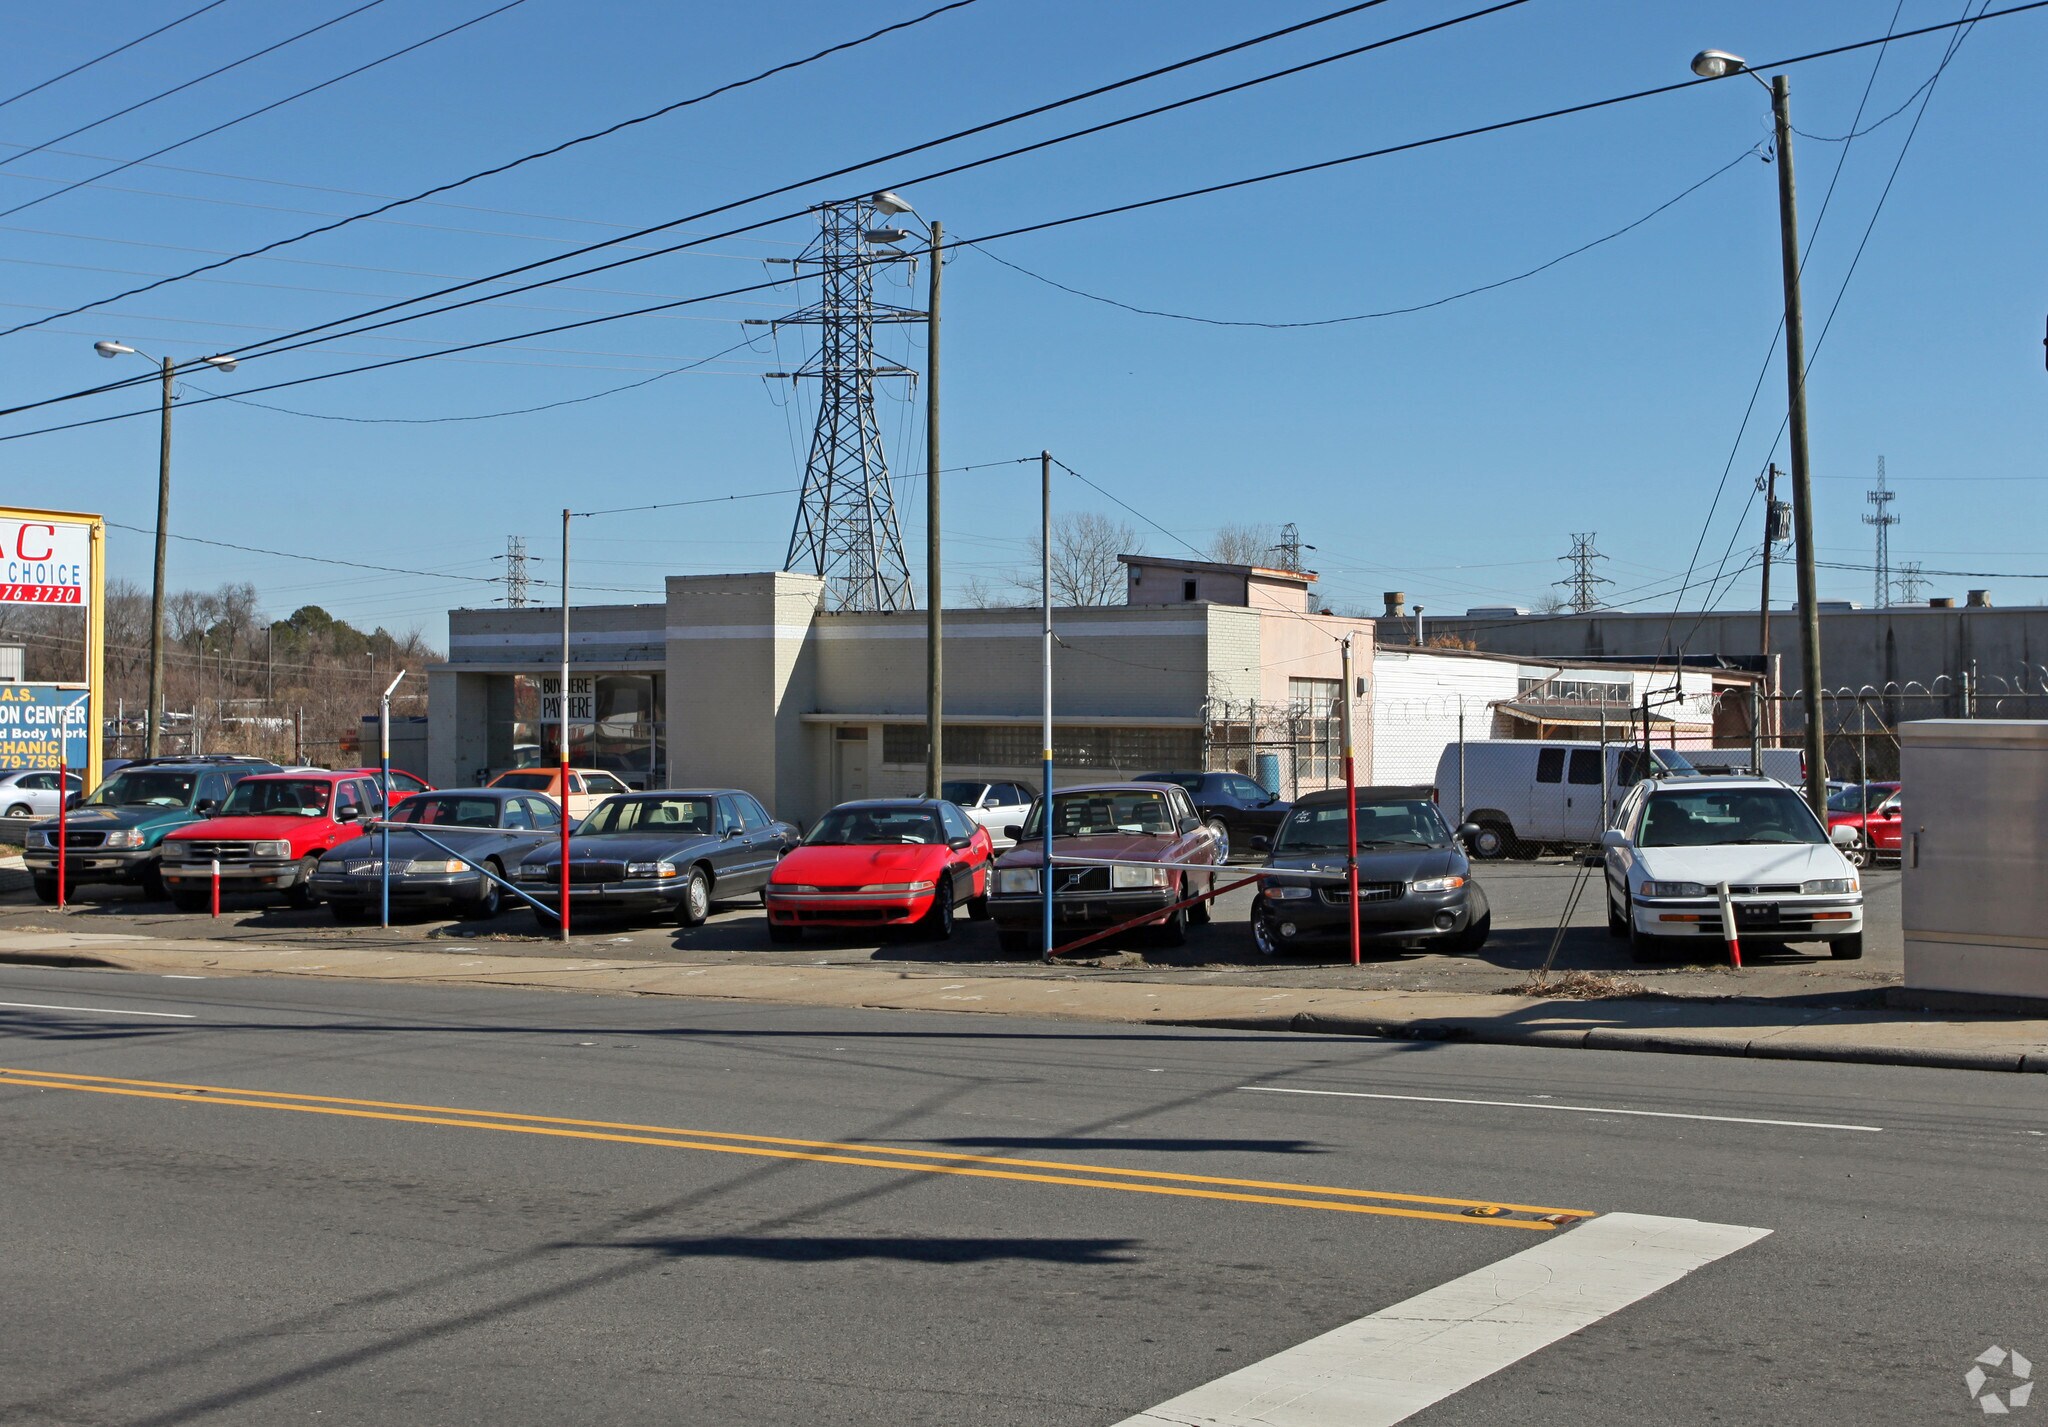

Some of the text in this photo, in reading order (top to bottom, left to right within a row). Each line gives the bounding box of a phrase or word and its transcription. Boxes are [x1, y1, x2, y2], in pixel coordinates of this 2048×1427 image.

[0, 524, 55, 561] C
[8, 561, 80, 585] CHOICE
[2, 585, 75, 602] 76.3730
[543, 678, 562, 694] BUY
[25, 705, 86, 724] CENTER
[543, 697, 562, 718] PAY
[12, 728, 48, 741] Body
[51, 727, 88, 739] Work
[0, 741, 59, 754] HANIC
